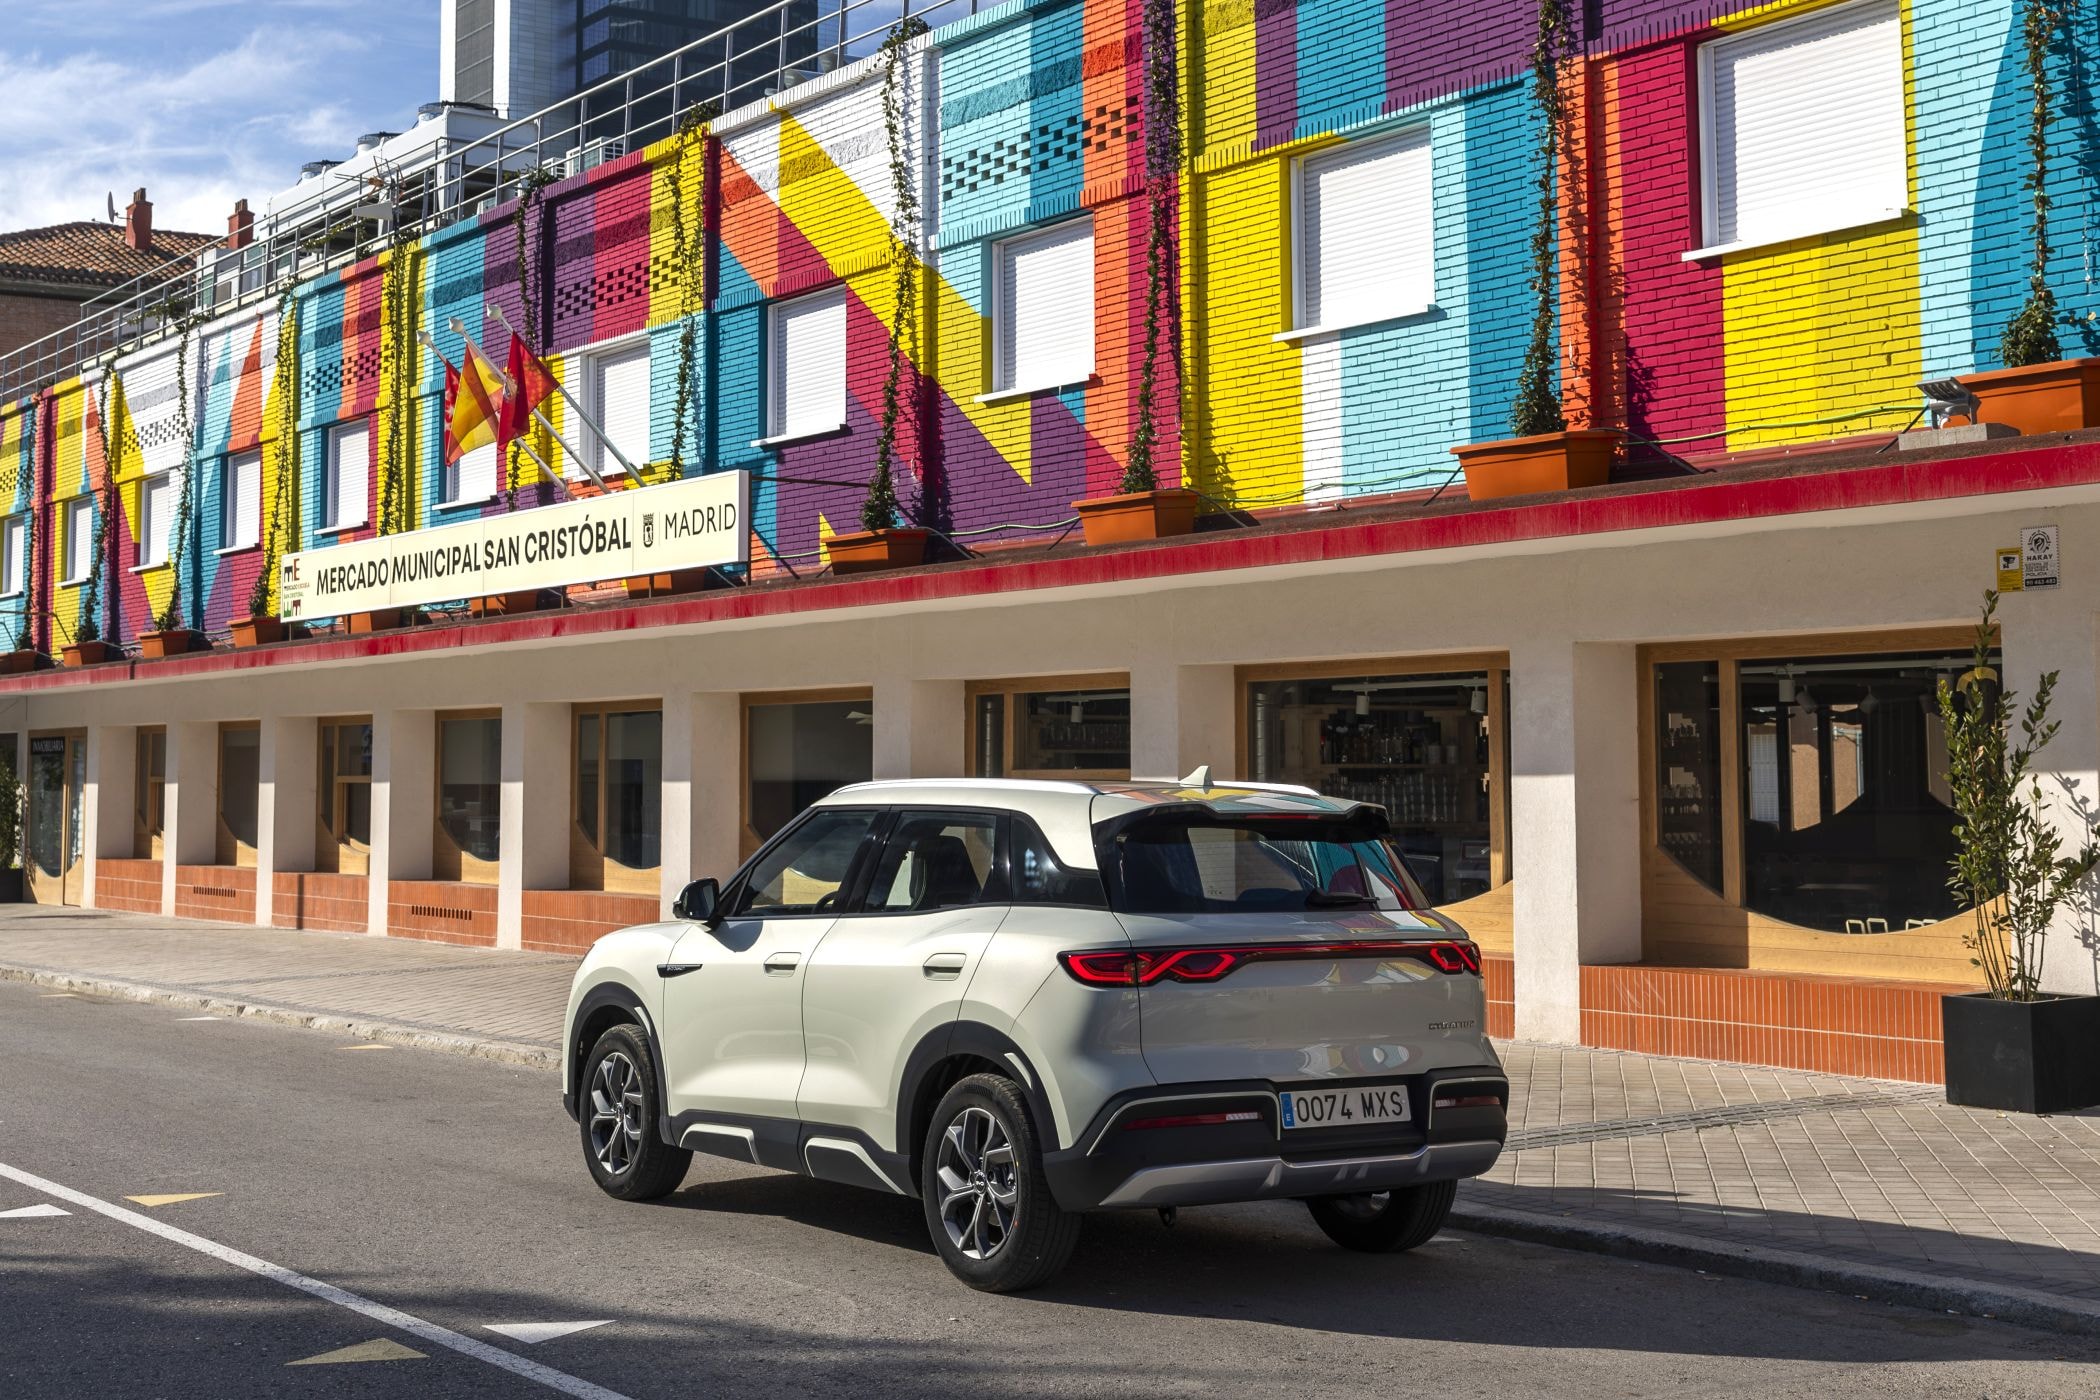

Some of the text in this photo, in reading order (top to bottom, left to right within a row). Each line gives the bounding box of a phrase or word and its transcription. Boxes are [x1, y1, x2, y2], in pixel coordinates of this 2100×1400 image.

[665, 503, 736, 540] MADRID
[316, 514, 632, 596] MERCADO MUNICIPAL SAN CRISTÓBAL
[1286, 1113, 1292, 1121] E
[1296, 1091, 1403, 1122] 0074 MXS
